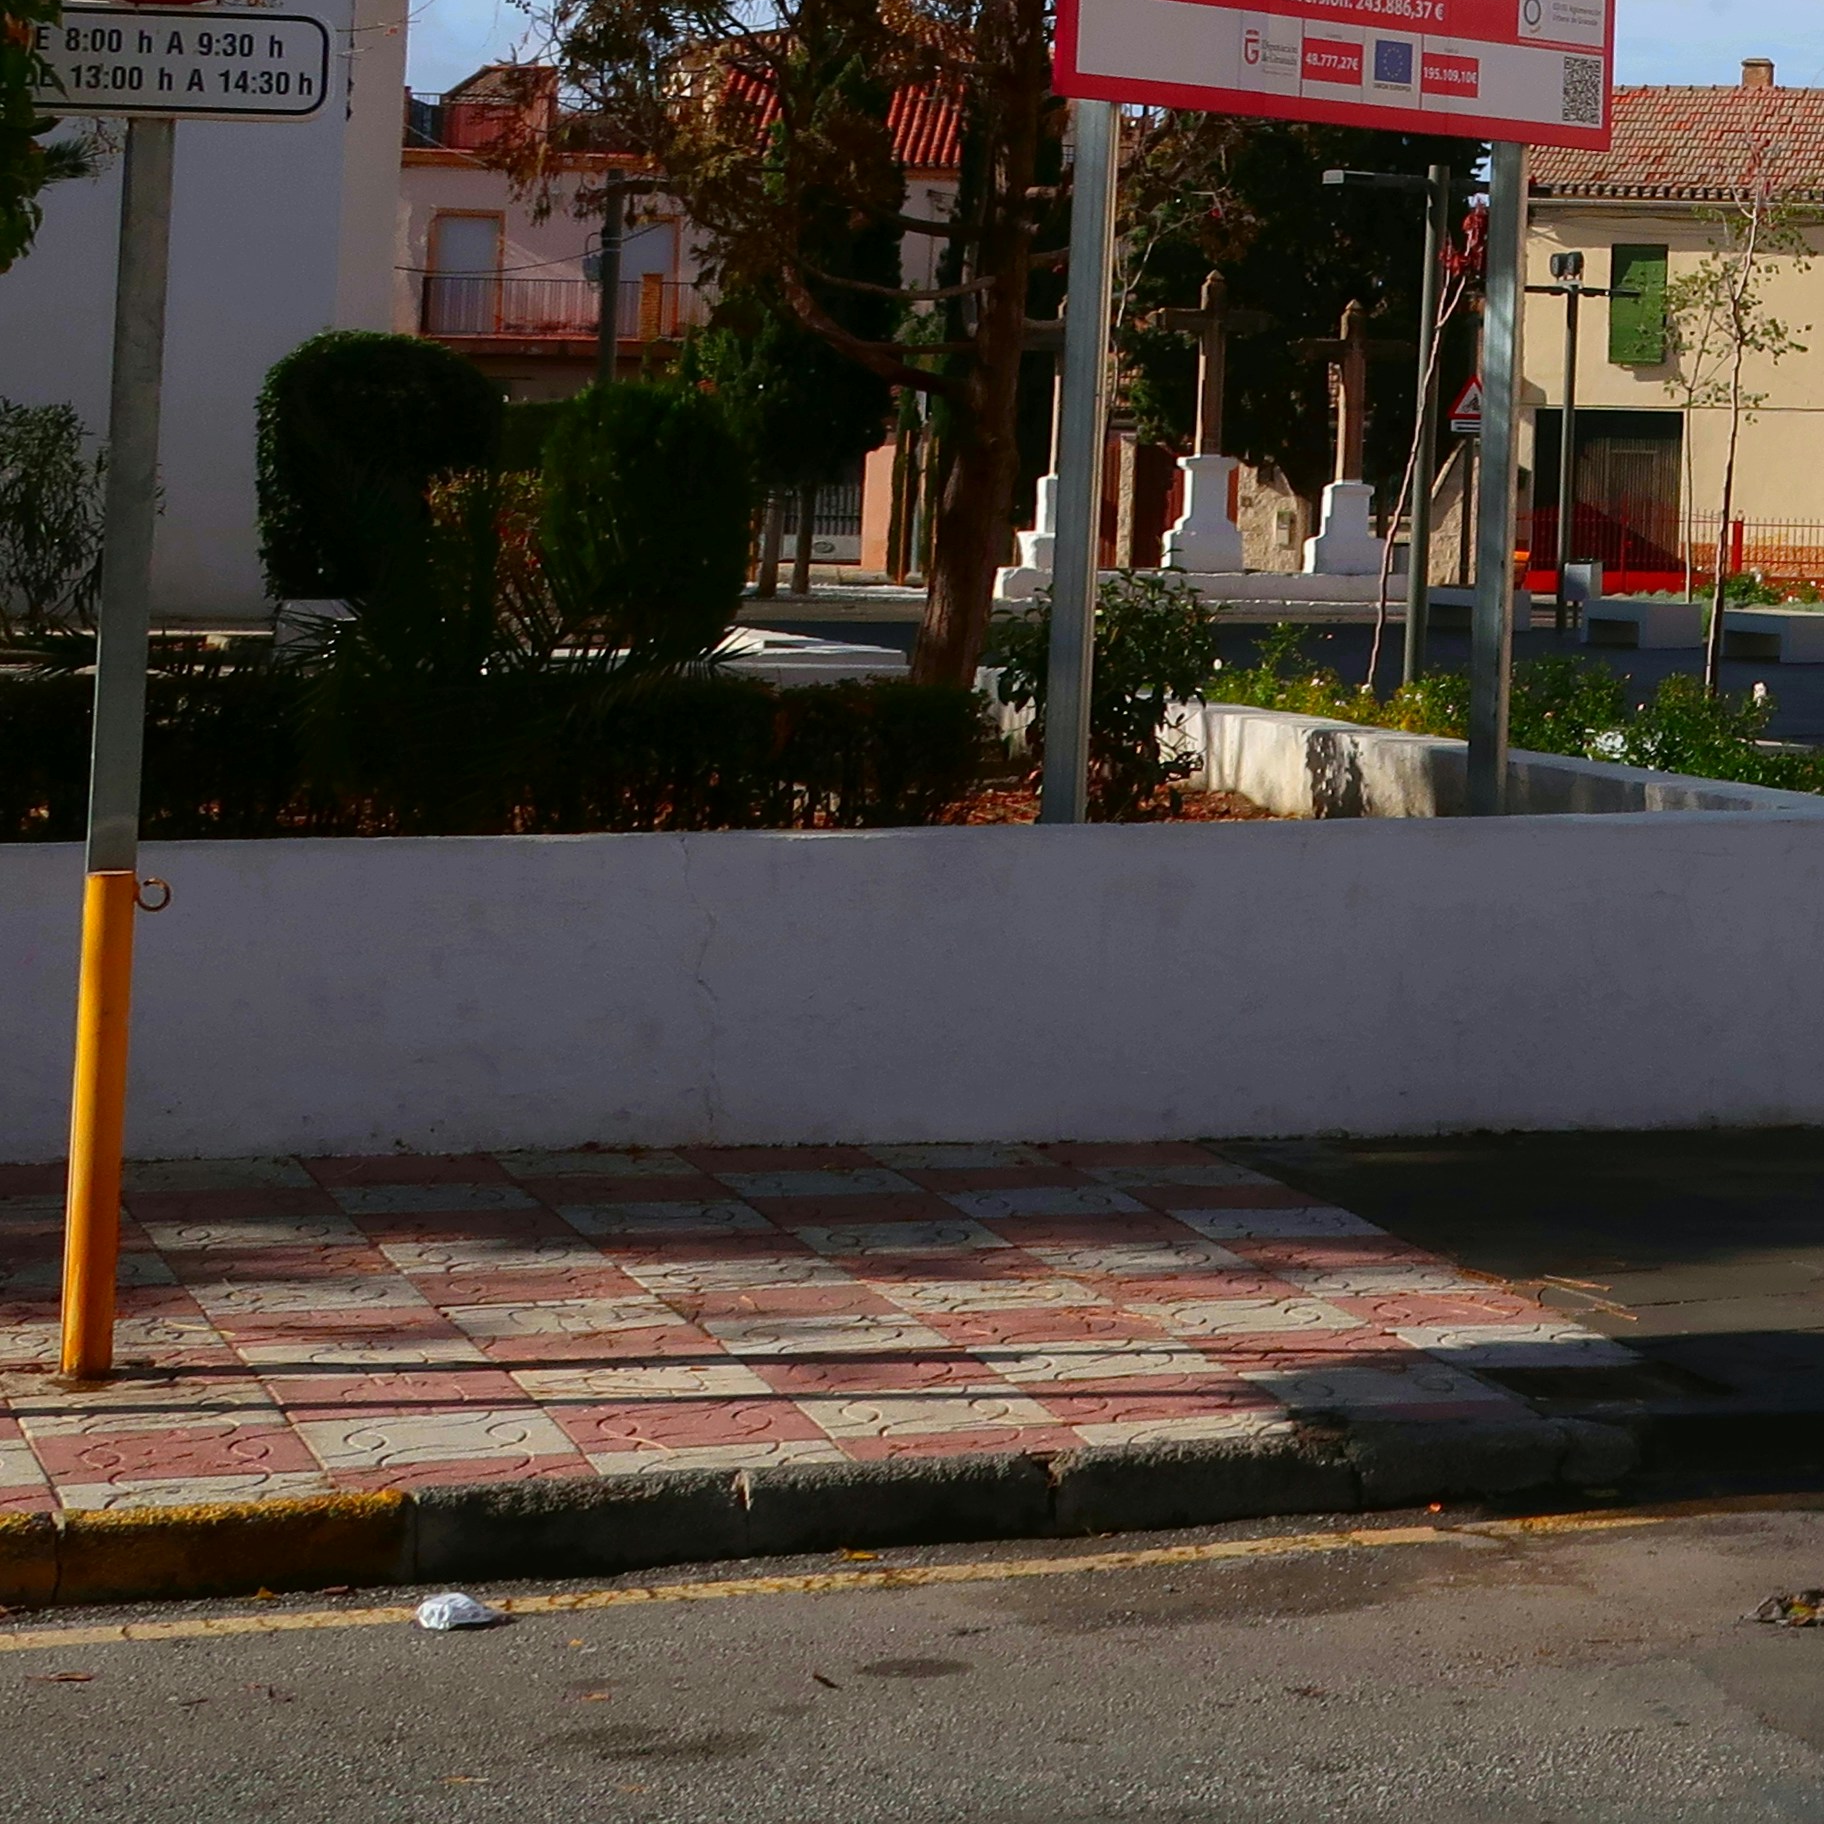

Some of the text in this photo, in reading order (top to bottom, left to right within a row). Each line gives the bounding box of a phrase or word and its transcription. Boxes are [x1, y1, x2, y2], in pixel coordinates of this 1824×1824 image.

[1435, 2, 1445, 21] €
[65, 27, 123, 53] 8:00
[138, 29, 153, 54] h
[166, 31, 184, 55] A
[198, 32, 254, 57] 9:30
[269, 34, 283, 58] h
[70, 64, 143, 90] 13:00
[158, 67, 173, 91] h
[186, 68, 204, 92] A
[218, 69, 290, 95] 14:30
[298, 72, 313, 96] h
